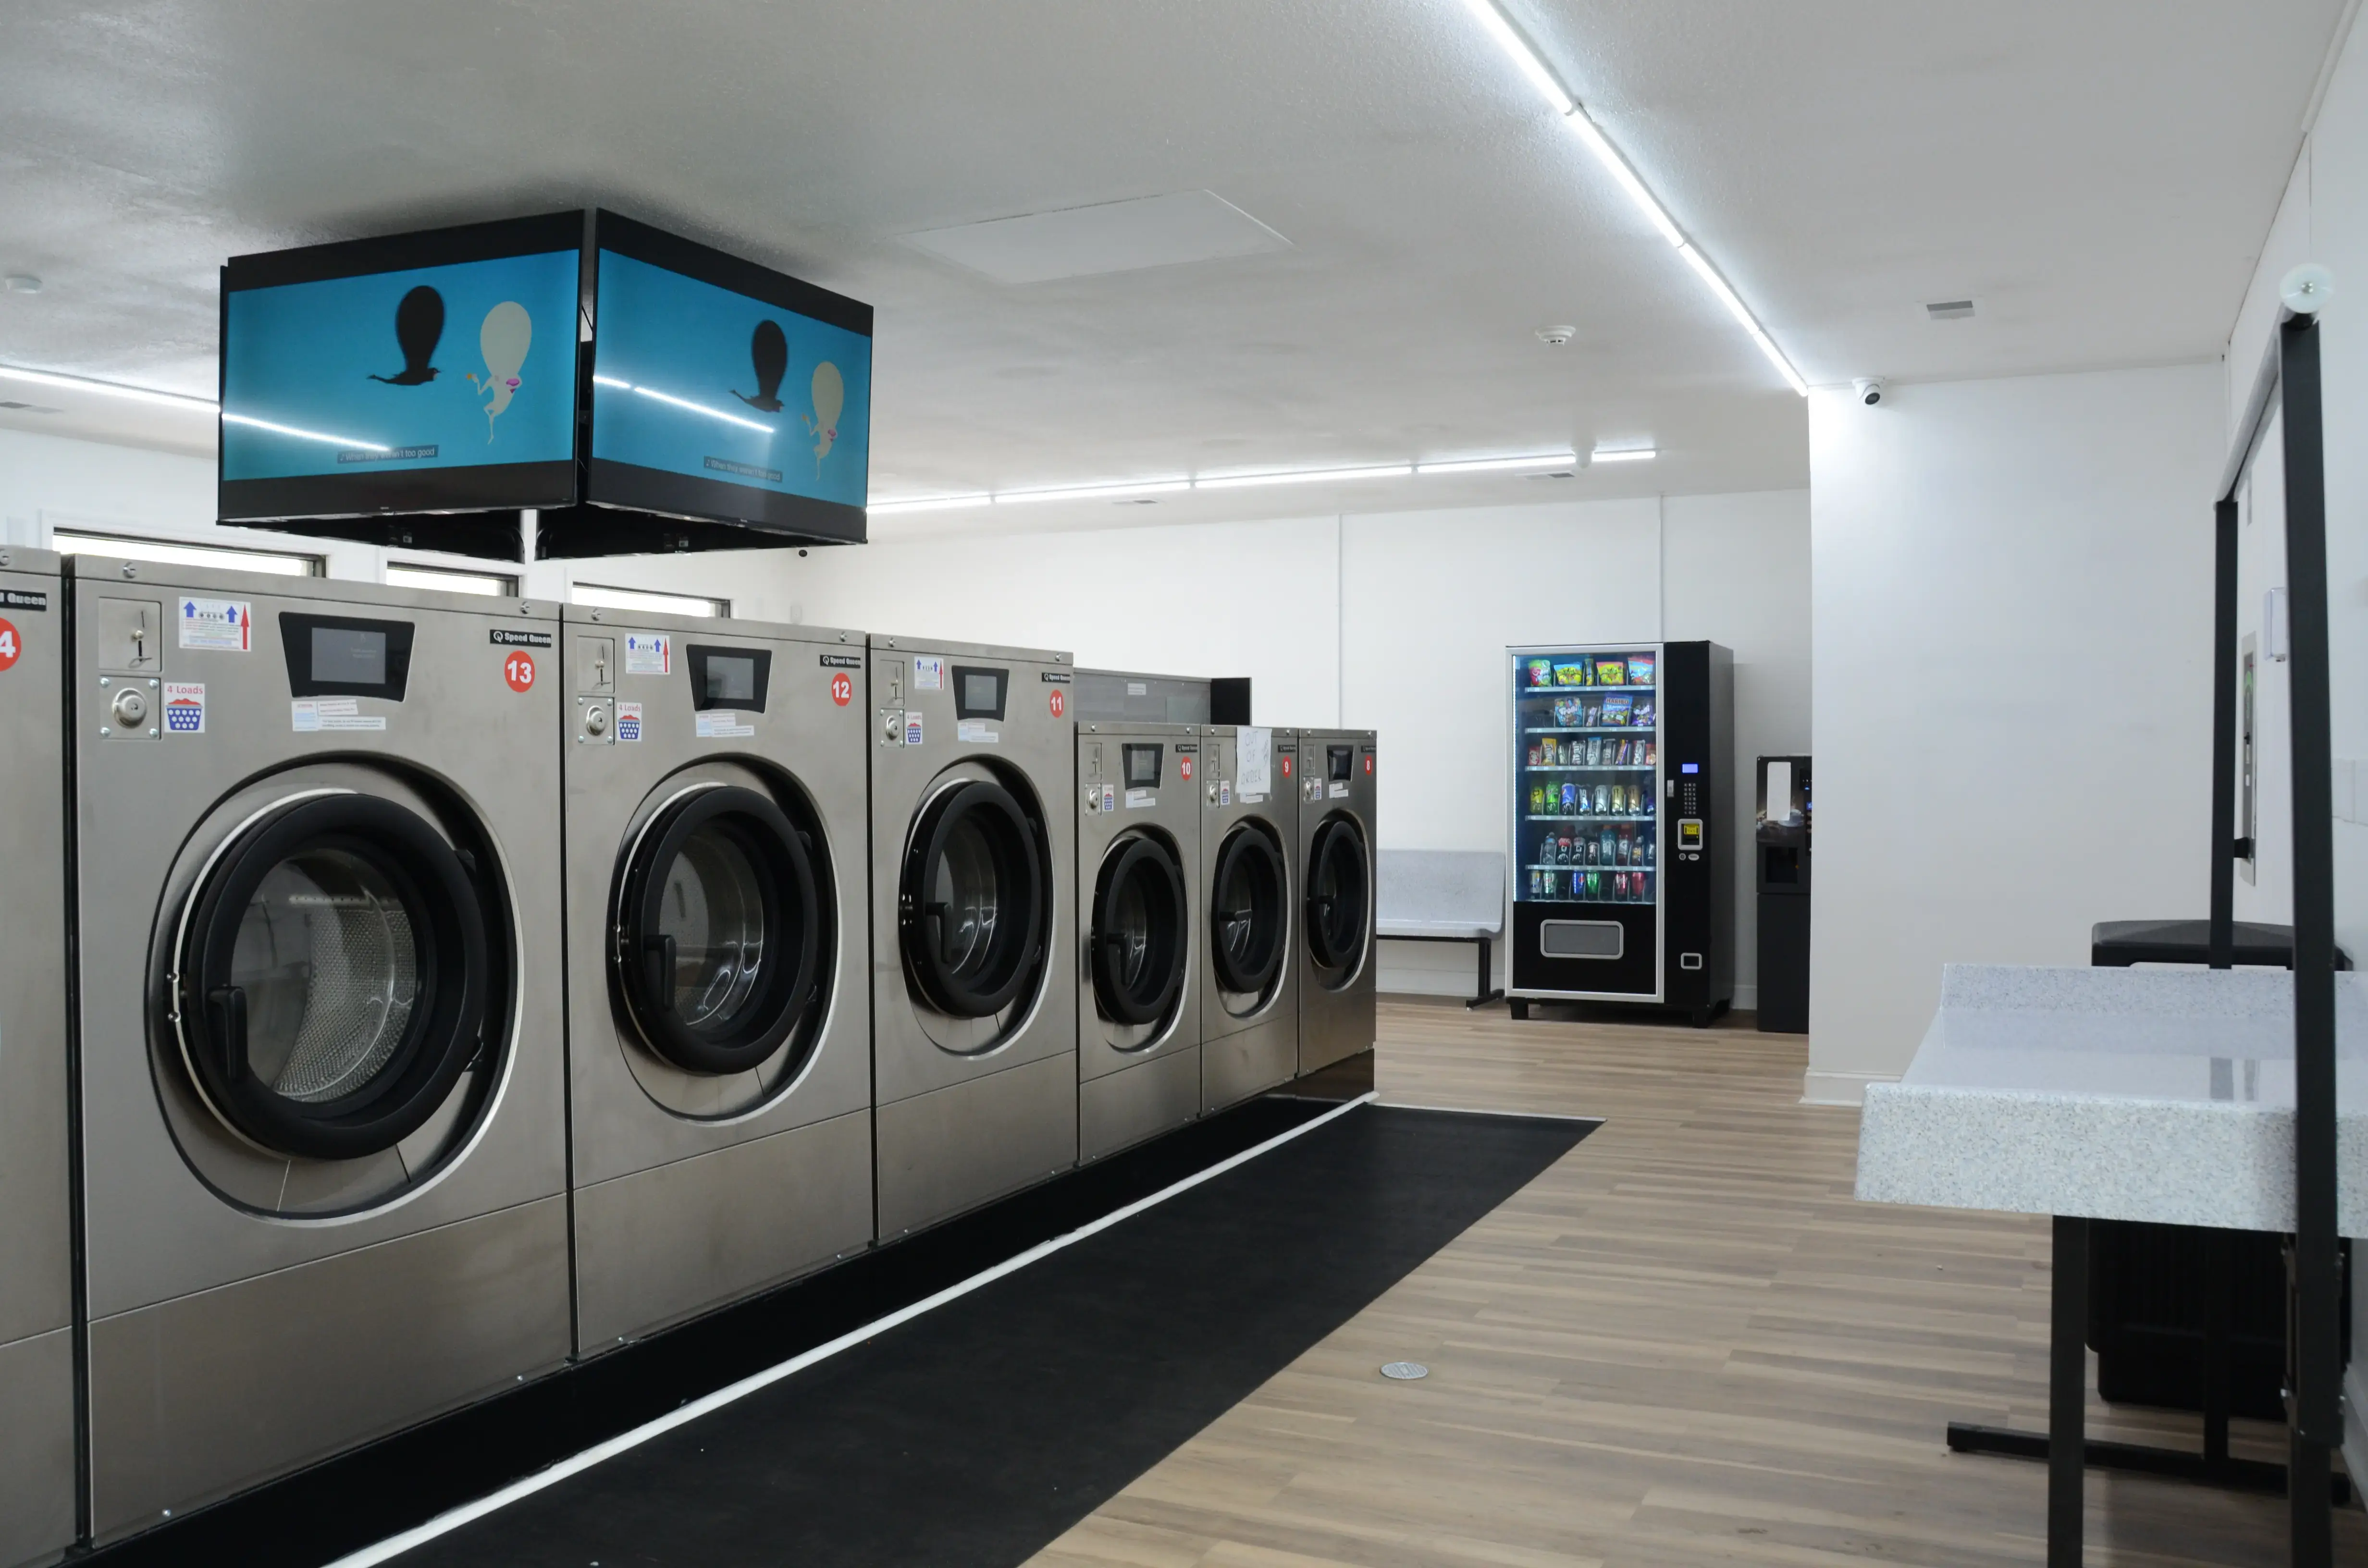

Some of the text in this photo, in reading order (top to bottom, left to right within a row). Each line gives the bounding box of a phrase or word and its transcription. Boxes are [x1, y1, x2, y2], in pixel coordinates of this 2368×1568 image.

[418, 448, 435, 458] good
[7, 593, 46, 606] Queen
[505, 632, 528, 643] Speed
[529, 634, 551, 644] Queen
[830, 657, 846, 665] Speed
[507, 660, 532, 684] 13
[177, 686, 203, 695] Loads
[833, 681, 849, 698] 12
[1051, 696, 1062, 711] 11
[1245, 731, 1258, 747] OUT
[1246, 749, 1255, 762] OF
[1182, 762, 1191, 775] 10
[1284, 761, 1289, 773] 9
[1367, 760, 1370, 771] 8
[1241, 769, 1262, 785] ORDER
